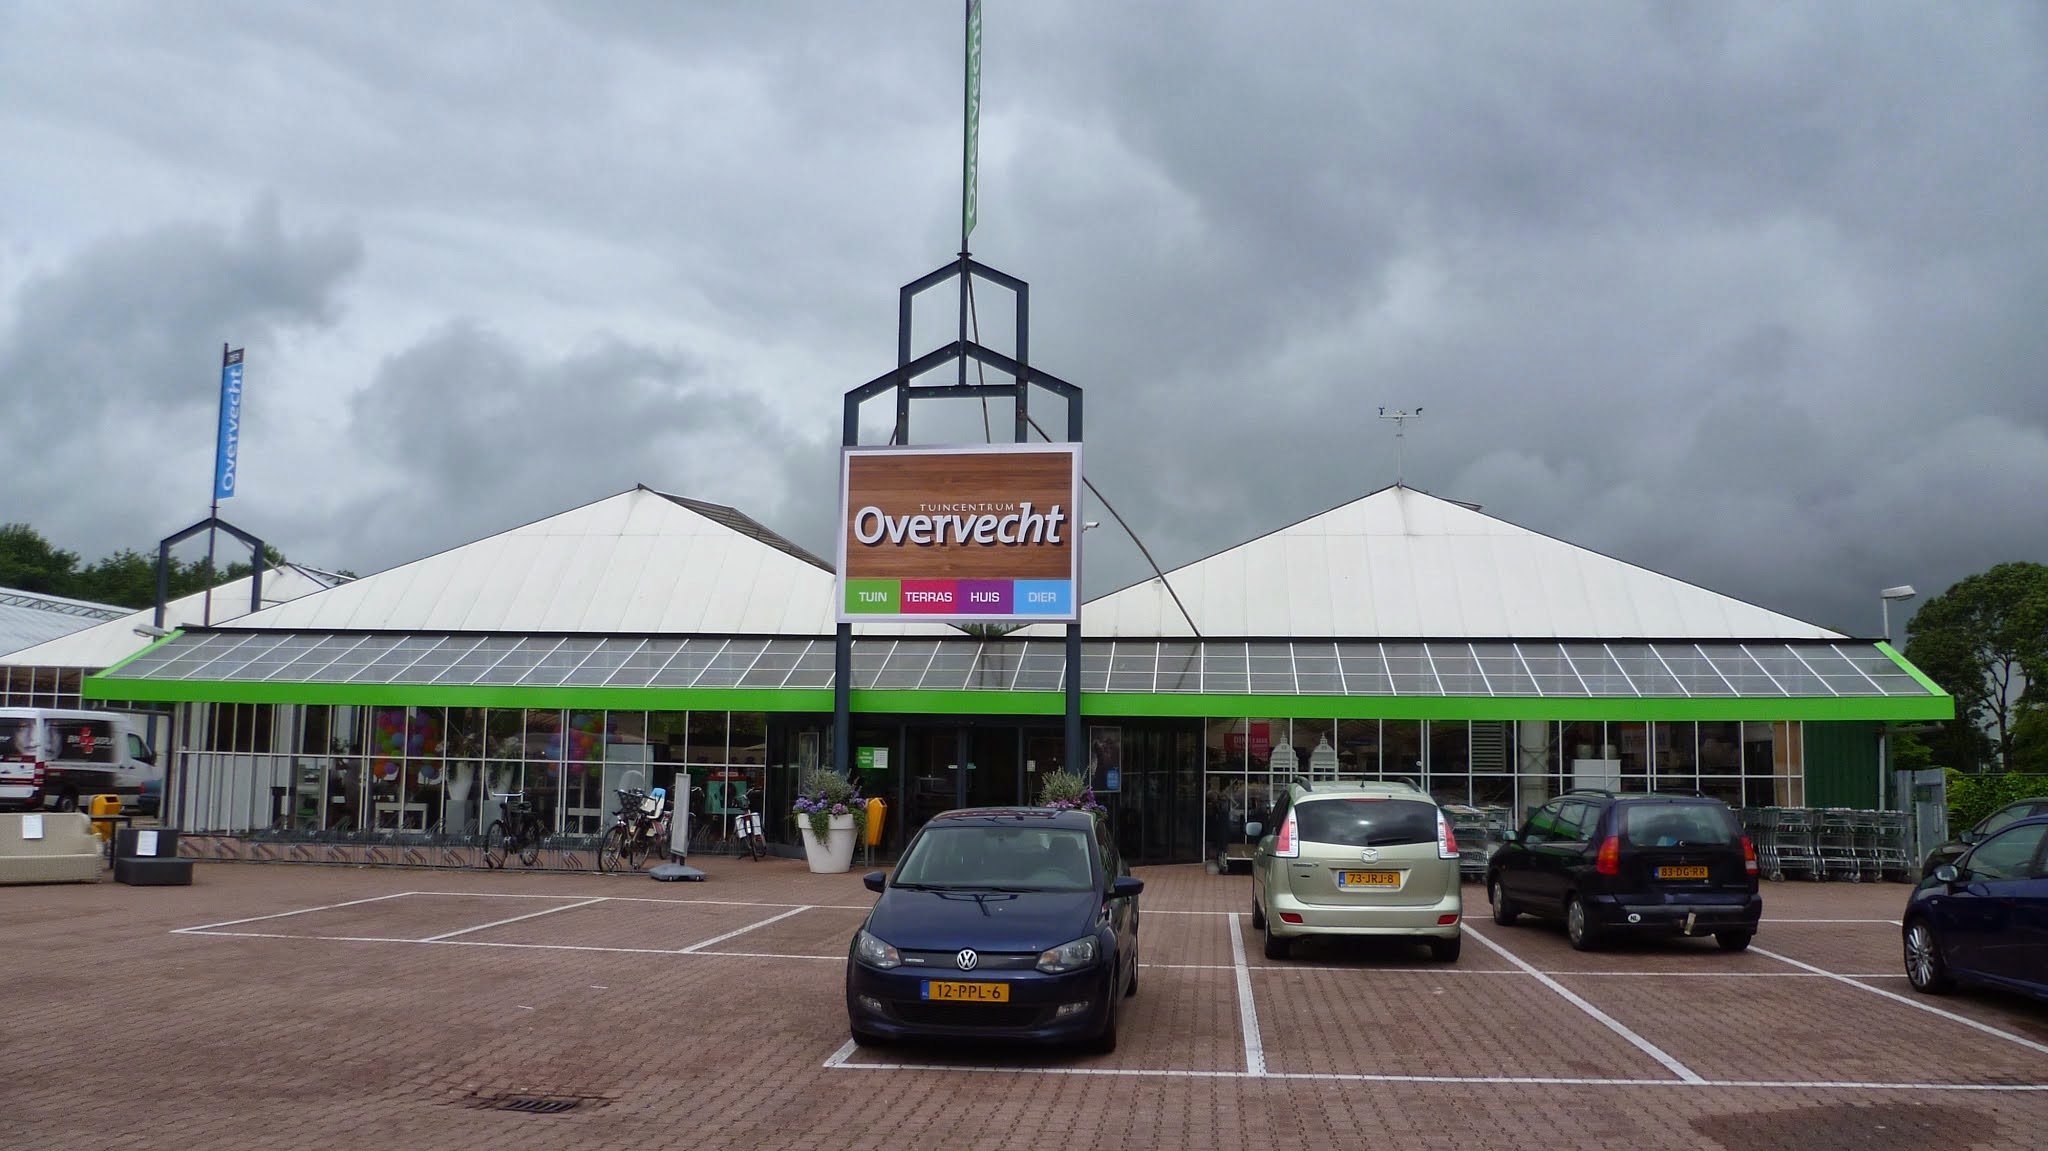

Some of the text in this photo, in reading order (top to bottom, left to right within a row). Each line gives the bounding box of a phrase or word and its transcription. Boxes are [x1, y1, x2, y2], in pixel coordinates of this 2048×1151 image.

[222, 367, 242, 492] Overvecht
[920, 503, 1014, 512] TUINCENTRUM
[854, 502, 1064, 544] Overvecht
[859, 592, 1057, 603] TUIN TERRAS HUIS DIER
[1661, 867, 1705, 877] 83-DG-RR
[1349, 873, 1394, 884] 73-JRJ-8
[937, 984, 1001, 999] 12-PPL-6
